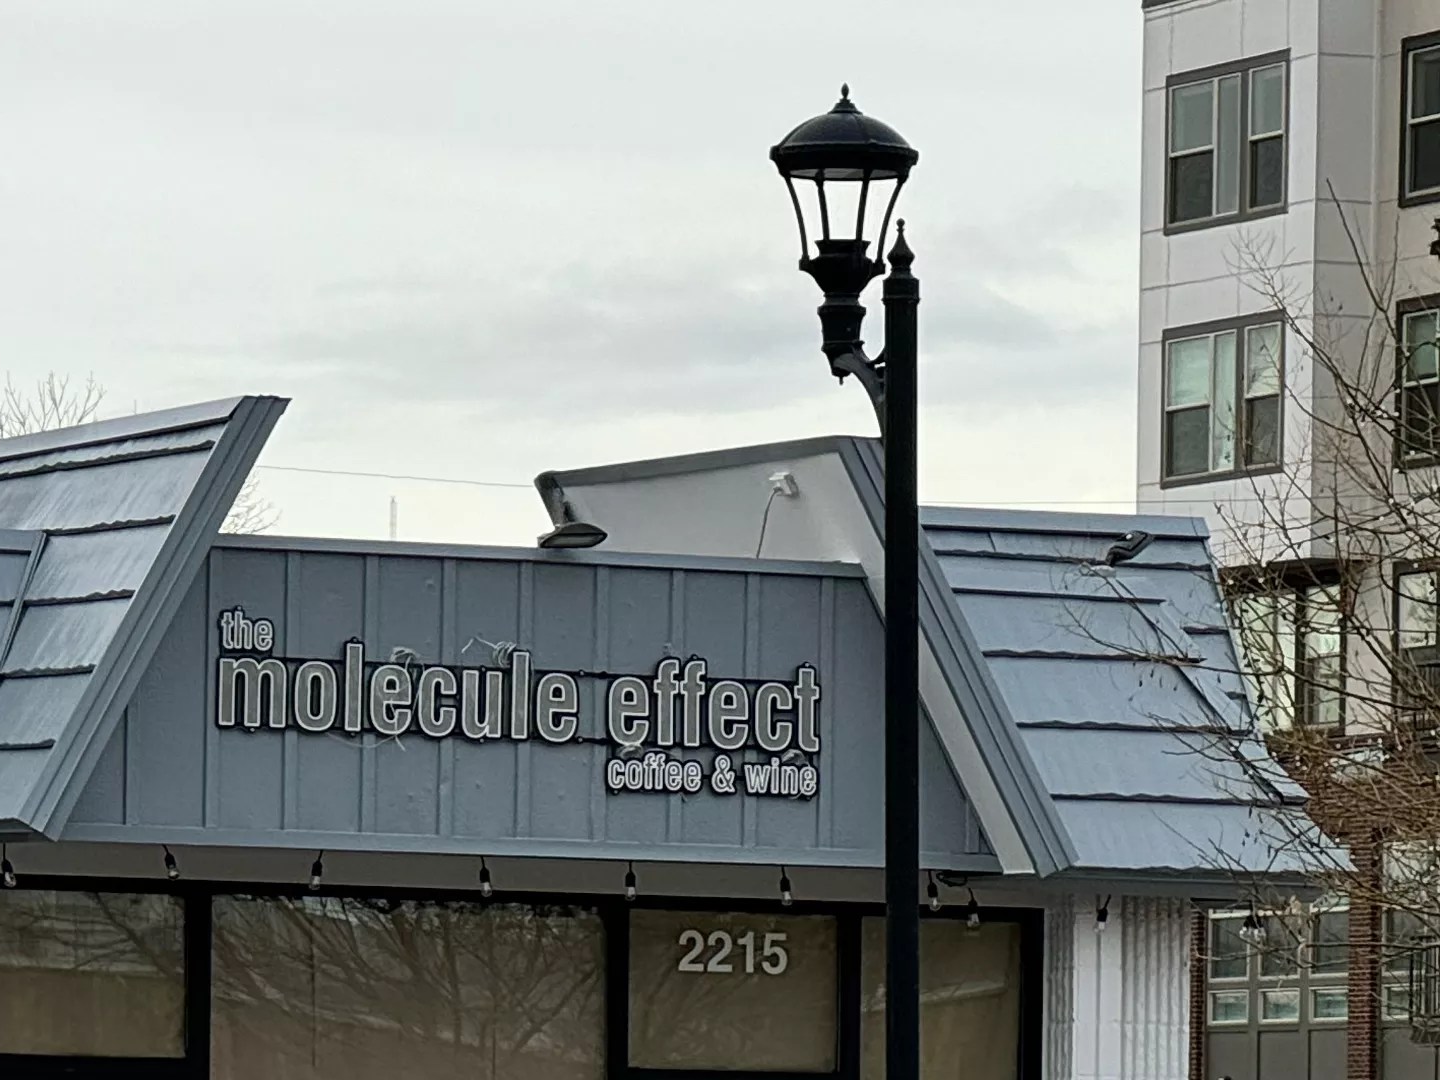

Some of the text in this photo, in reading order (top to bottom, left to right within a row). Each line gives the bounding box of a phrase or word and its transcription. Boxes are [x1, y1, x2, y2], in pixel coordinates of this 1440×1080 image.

[221, 609, 274, 651] the
[217, 642, 820, 753] molecule effect
[607, 752, 818, 796] coffee & wine
[678, 929, 789, 975] 2215
